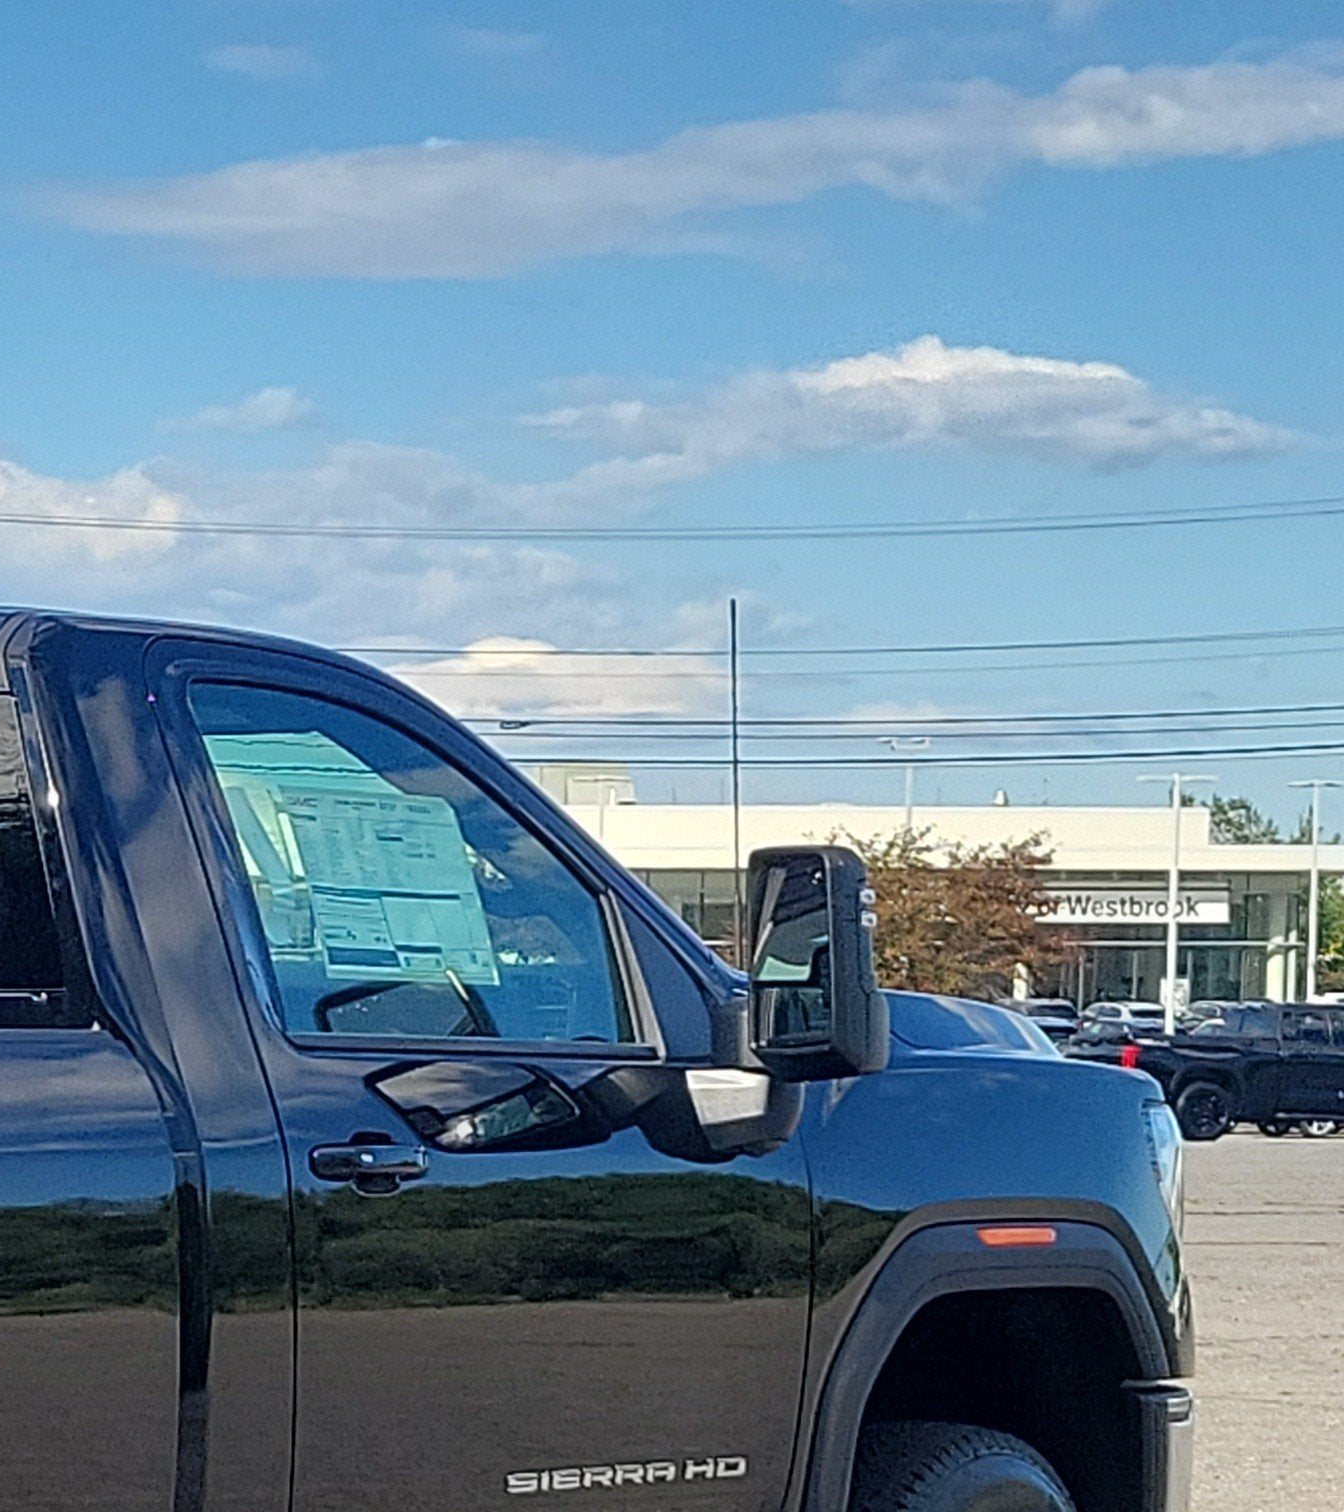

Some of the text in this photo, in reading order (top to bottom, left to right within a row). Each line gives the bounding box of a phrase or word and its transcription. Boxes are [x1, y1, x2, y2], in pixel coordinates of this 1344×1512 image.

[1066, 895, 1199, 917] Westbrook
[506, 1456, 748, 1494] SIERRA HD
